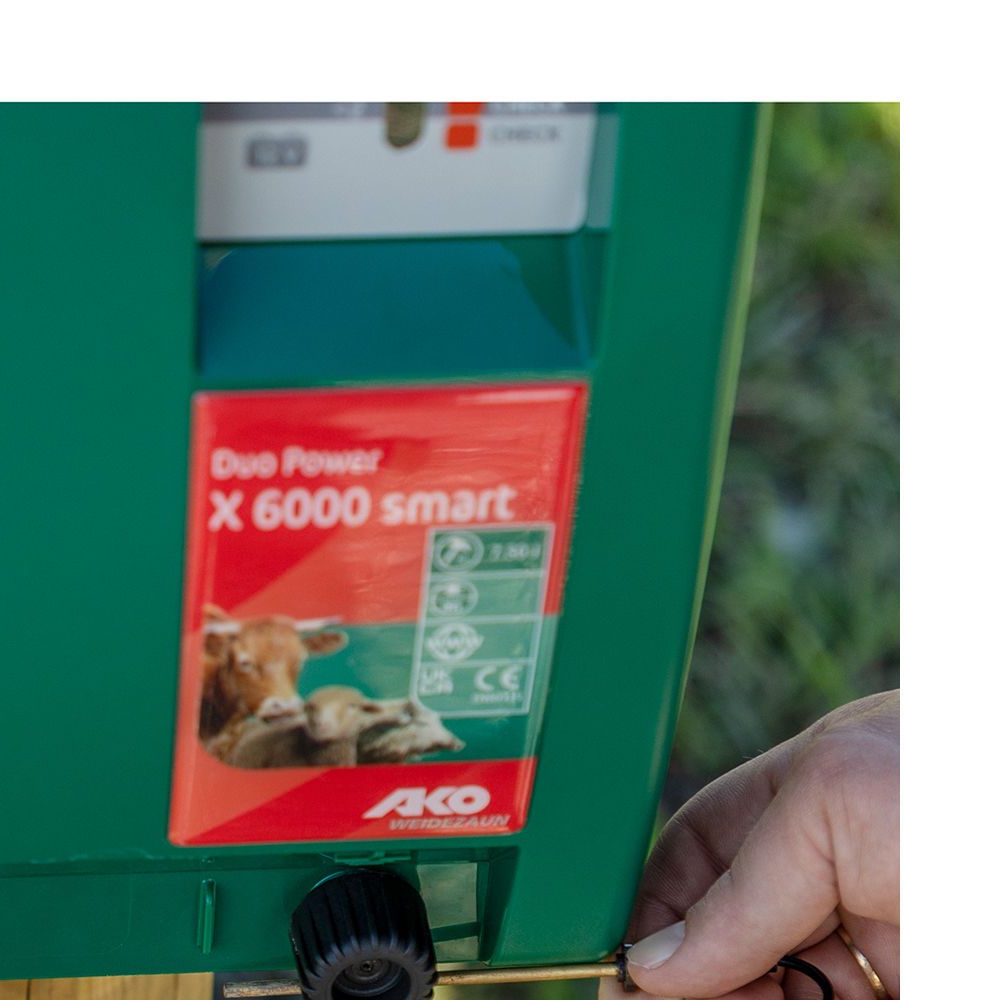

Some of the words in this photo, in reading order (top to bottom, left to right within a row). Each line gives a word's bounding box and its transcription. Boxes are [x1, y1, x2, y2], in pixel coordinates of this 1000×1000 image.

[211, 447, 278, 480] Duo
[281, 445, 383, 478] Power
[208, 489, 245, 532] X
[252, 486, 373, 530] 6000
[381, 485, 518, 526] smart
[361, 784, 491, 819] AKO
[388, 815, 511, 831] WEIDEZAUN
